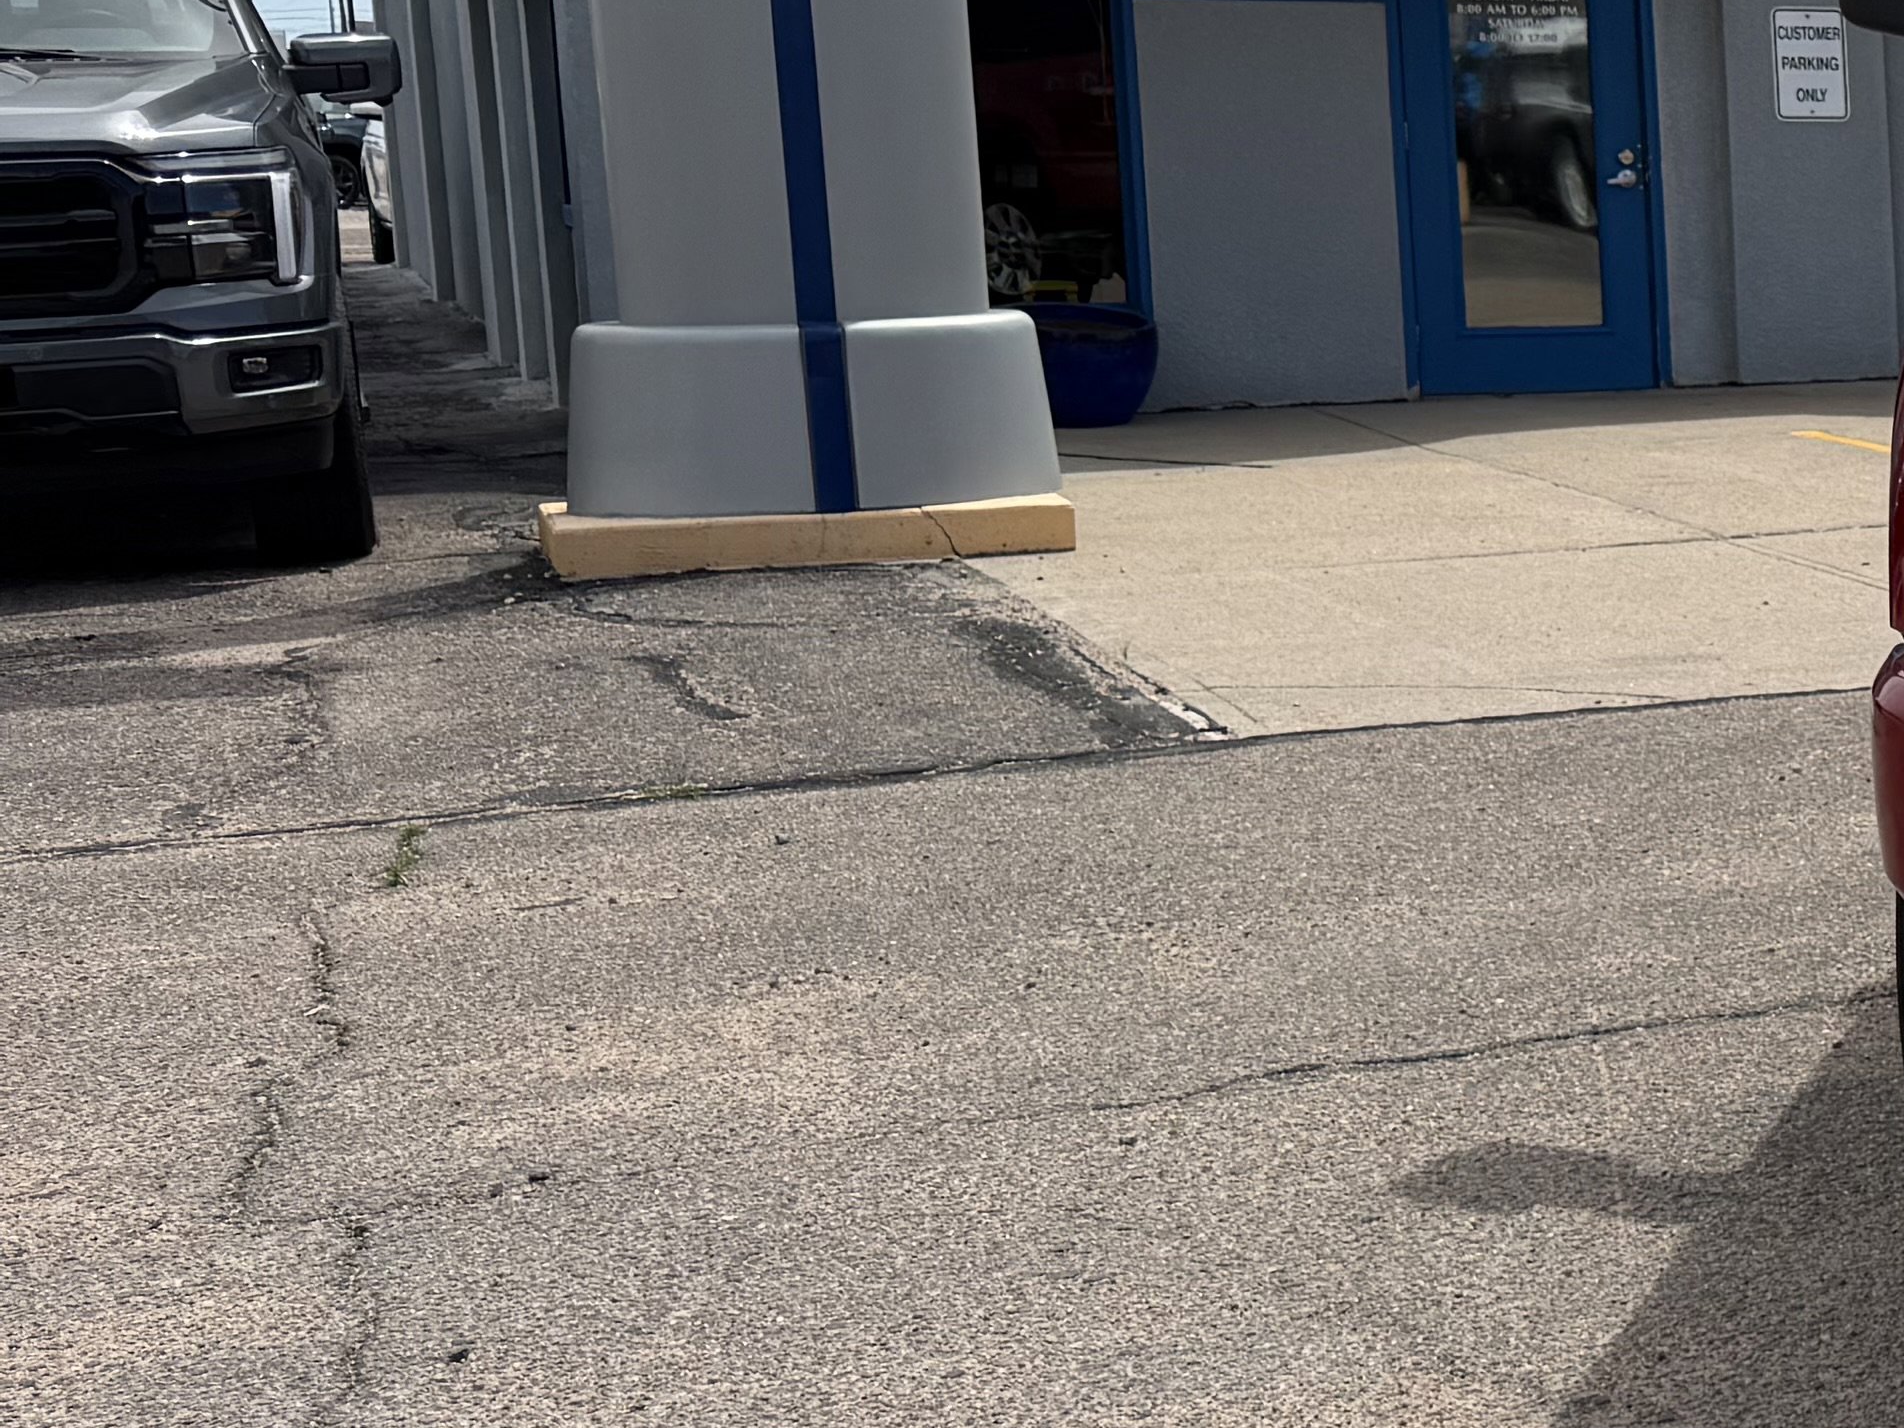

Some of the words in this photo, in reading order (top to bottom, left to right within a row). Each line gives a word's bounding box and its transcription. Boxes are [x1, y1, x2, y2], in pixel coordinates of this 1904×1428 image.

[1456, 3, 1482, 15] 8:00
[1487, 4, 1506, 15] AM
[1510, 4, 1527, 15] TO
[1530, 5, 1556, 16] 6:00
[1560, 6, 1578, 16] PM
[1487, 17, 1546, 29] SATURDAY
[1777, 25, 1841, 41] CUSTOMER
[1781, 55, 1840, 71] PARKING
[1796, 87, 1828, 103] ONLY
